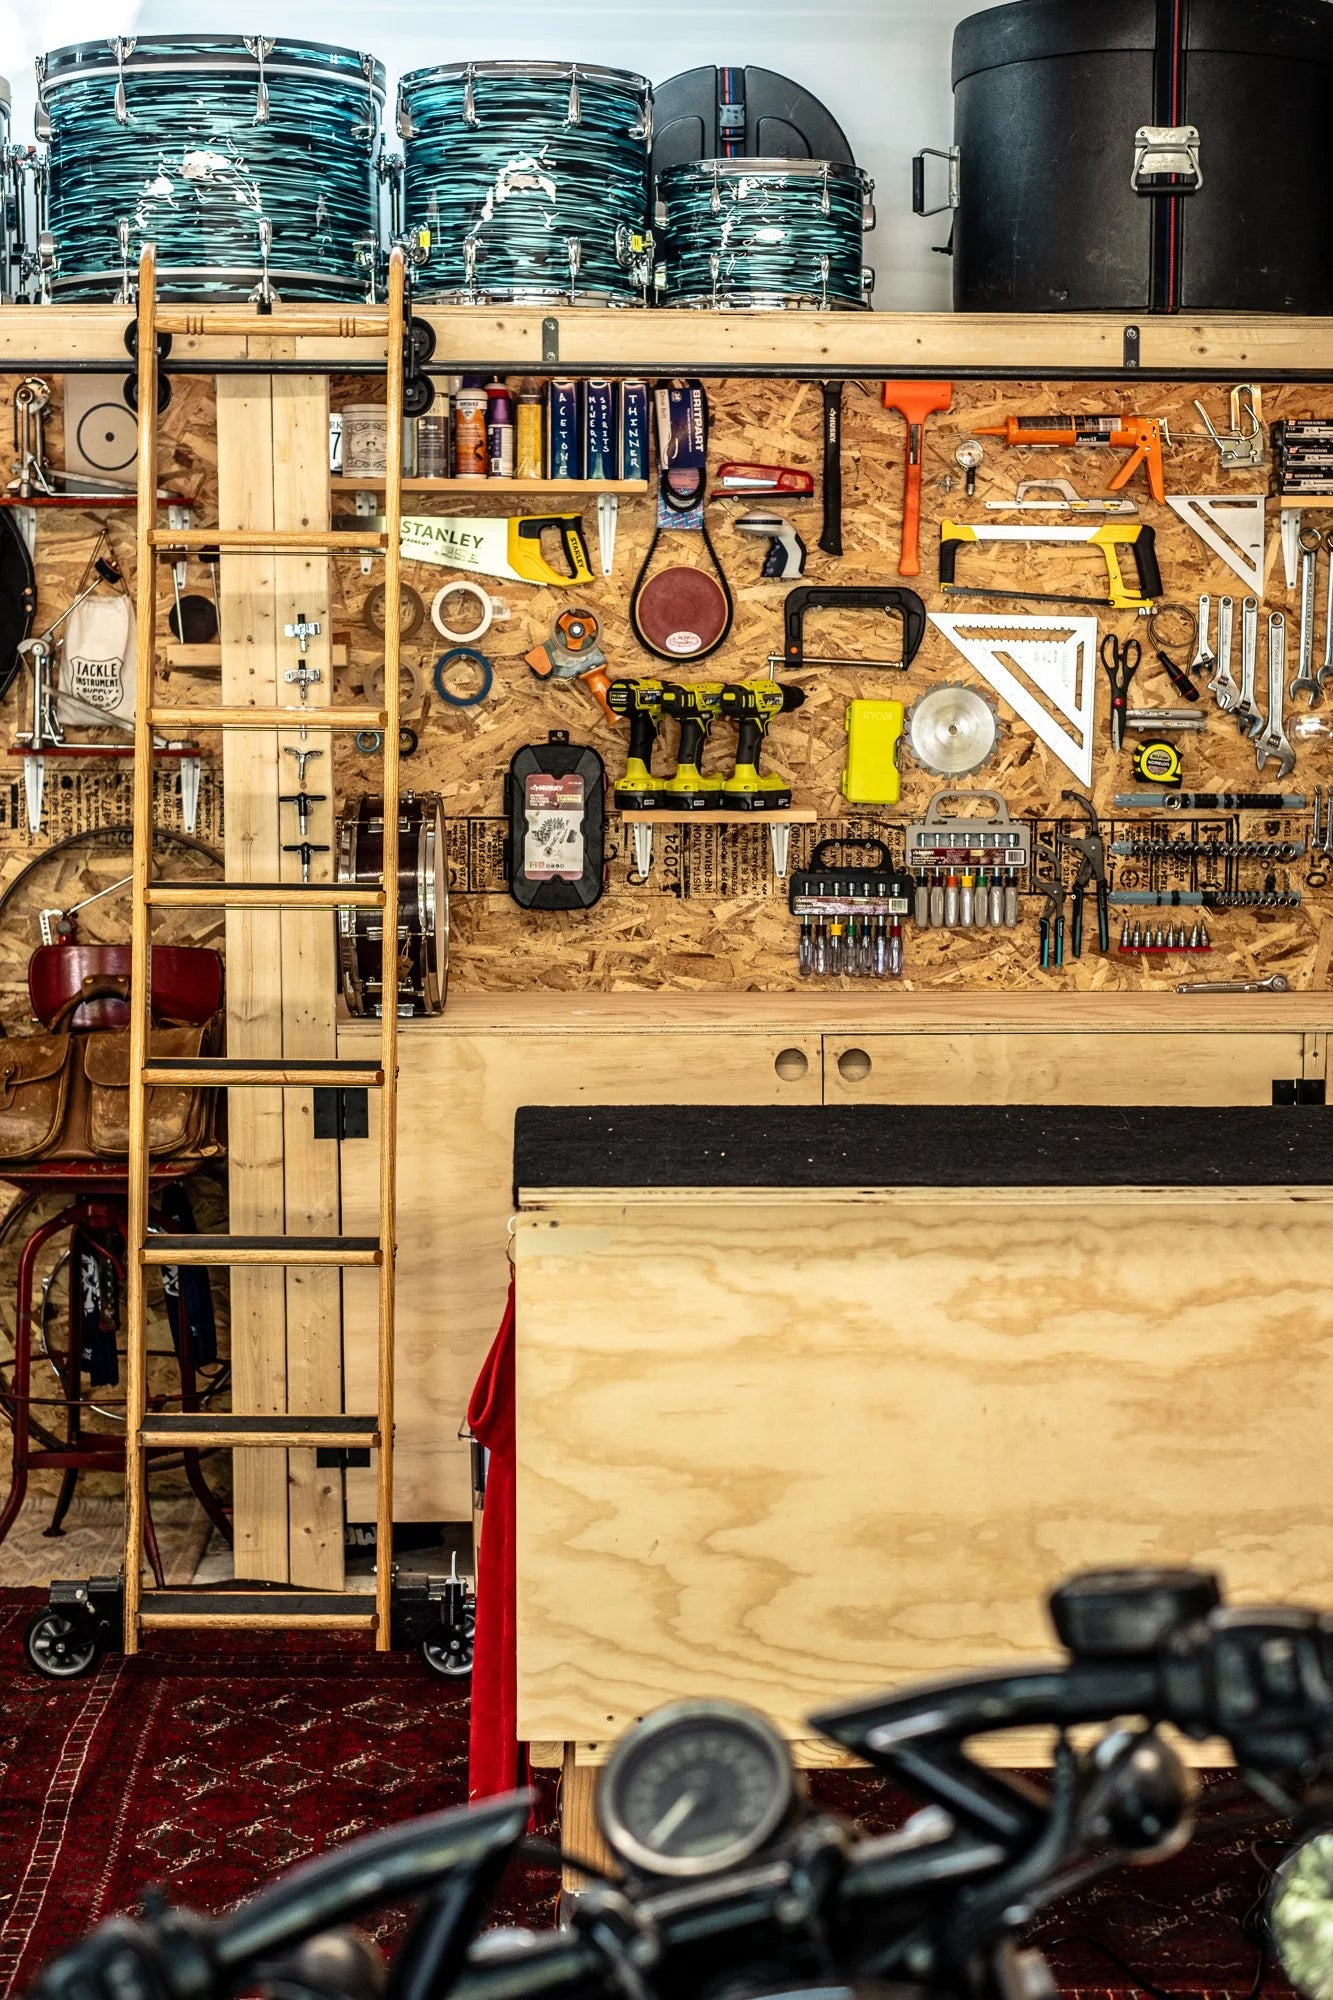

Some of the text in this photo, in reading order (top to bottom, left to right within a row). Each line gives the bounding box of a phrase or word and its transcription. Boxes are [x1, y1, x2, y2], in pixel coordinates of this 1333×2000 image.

[559, 392, 568, 474] ACETONE
[588, 396, 598, 452] MINERAL
[600, 396, 610, 452] SPIRITS
[628, 394, 640, 468] THINNER
[692, 389, 704, 452] BRITPART
[401, 520, 484, 548] STANLEY
[570, 538, 584, 568] STANLEY
[76, 662, 117, 677] TACKLE
[76, 677, 118, 687] INSTRUMENT
[864, 712, 892, 720] RYOBI
[664, 834, 678, 878] 2024
[694, 825, 702, 894] INSTALLATION
[704, 825, 713, 894] INFORMATION
